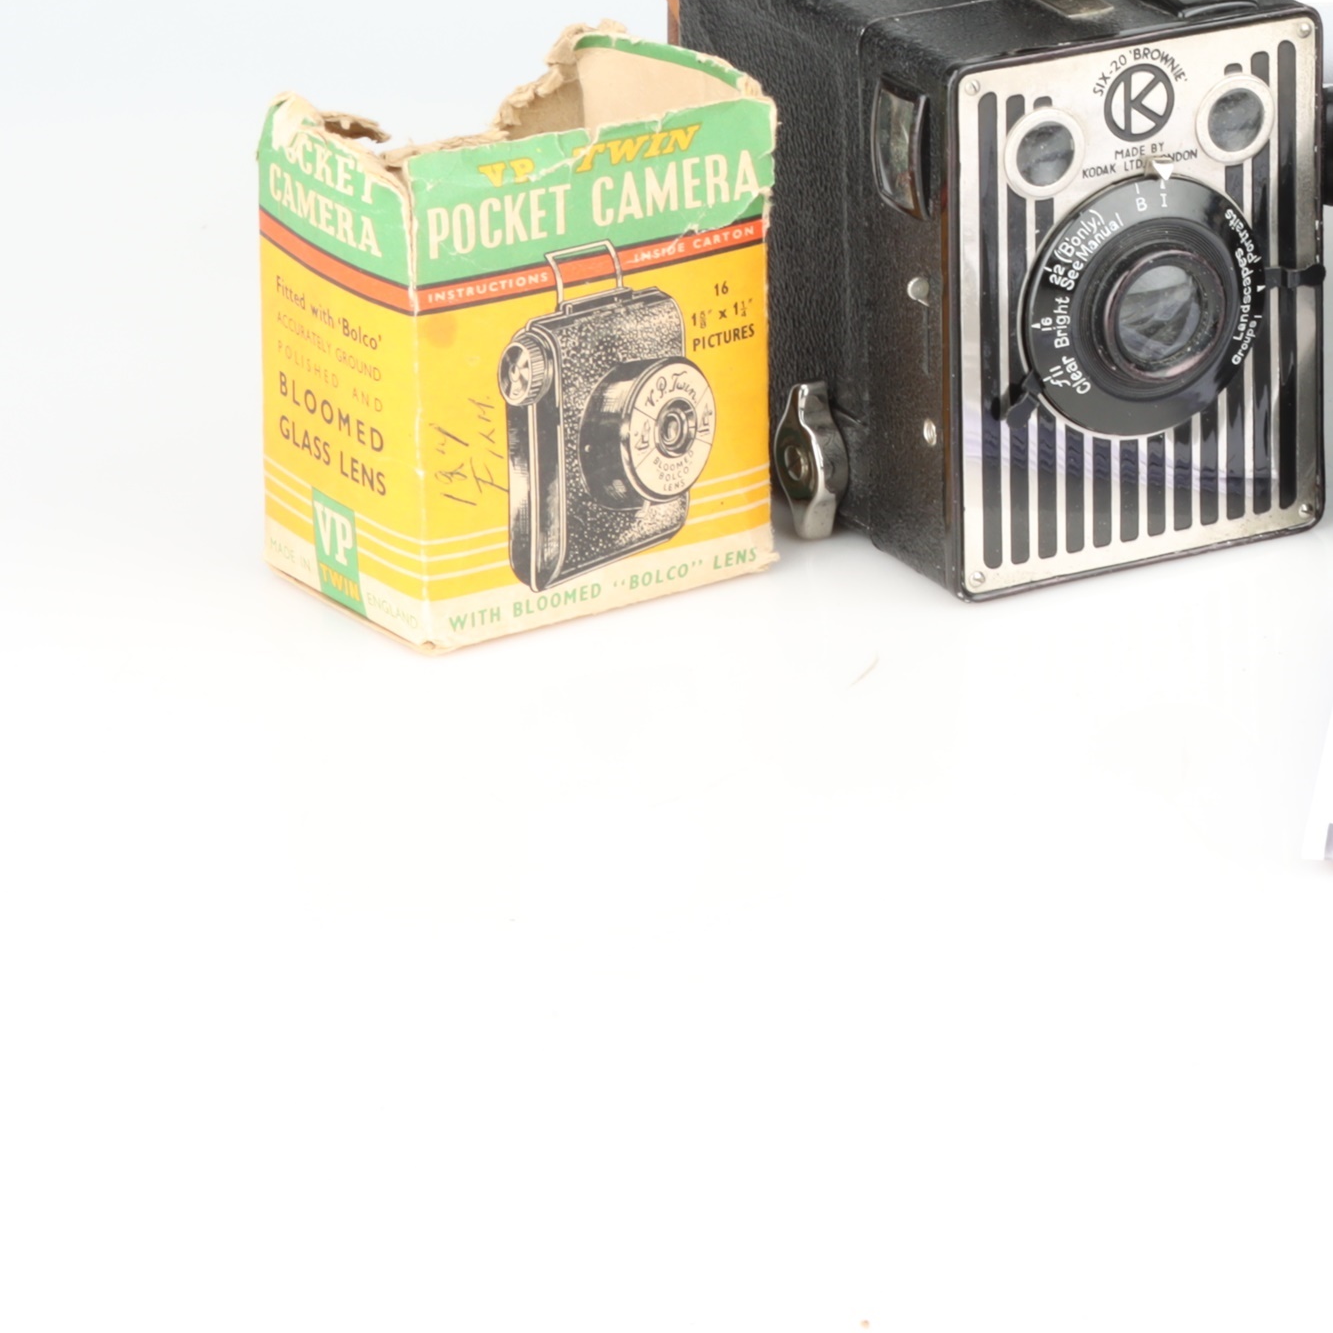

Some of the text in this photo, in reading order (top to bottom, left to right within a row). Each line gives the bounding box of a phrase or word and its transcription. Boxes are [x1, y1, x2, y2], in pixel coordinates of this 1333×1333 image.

[1093, 54, 1127, 97] SIX-20
[275, 130, 376, 205] OCKET
[572, 124, 703, 174] TWIN
[1082, 163, 1117, 179] KODAK
[1115, 142, 1165, 160] MADE BY
[269, 163, 383, 258] CAMERA
[427, 149, 760, 260] POCKET CAMERA
[1135, 197, 1148, 212] B
[1060, 212, 1124, 291] See Manual
[1224, 208, 1258, 264] Portraits
[428, 225, 756, 303] INSTRUCTIONS INSIDE CARTON
[714, 280, 729, 297] 16
[276, 275, 306, 310] Fitted
[310, 303, 334, 329] with
[1232, 247, 1254, 341] Landscapes
[277, 311, 382, 382] ACCURATELY GROUND
[693, 323, 755, 352] PICTURES
[1040, 316, 1053, 332] 16
[1054, 296, 1070, 348] Bright
[1231, 320, 1257, 365] Groups
[277, 340, 384, 413] POLISHED AND
[1062, 355, 1092, 395] Clear
[279, 370, 385, 453] BLOOMED
[279, 414, 387, 497] GLASS LENS
[653, 450, 694, 471] BLOOMED
[663, 480, 686, 492] LENS
[314, 500, 353, 567] VP
[270, 536, 418, 629] MADE IN ENGLAND
[319, 562, 361, 602] TWIN
[449, 606, 501, 633] WITH
[512, 581, 602, 618] BLOOMED
[712, 546, 758, 570] LENS
